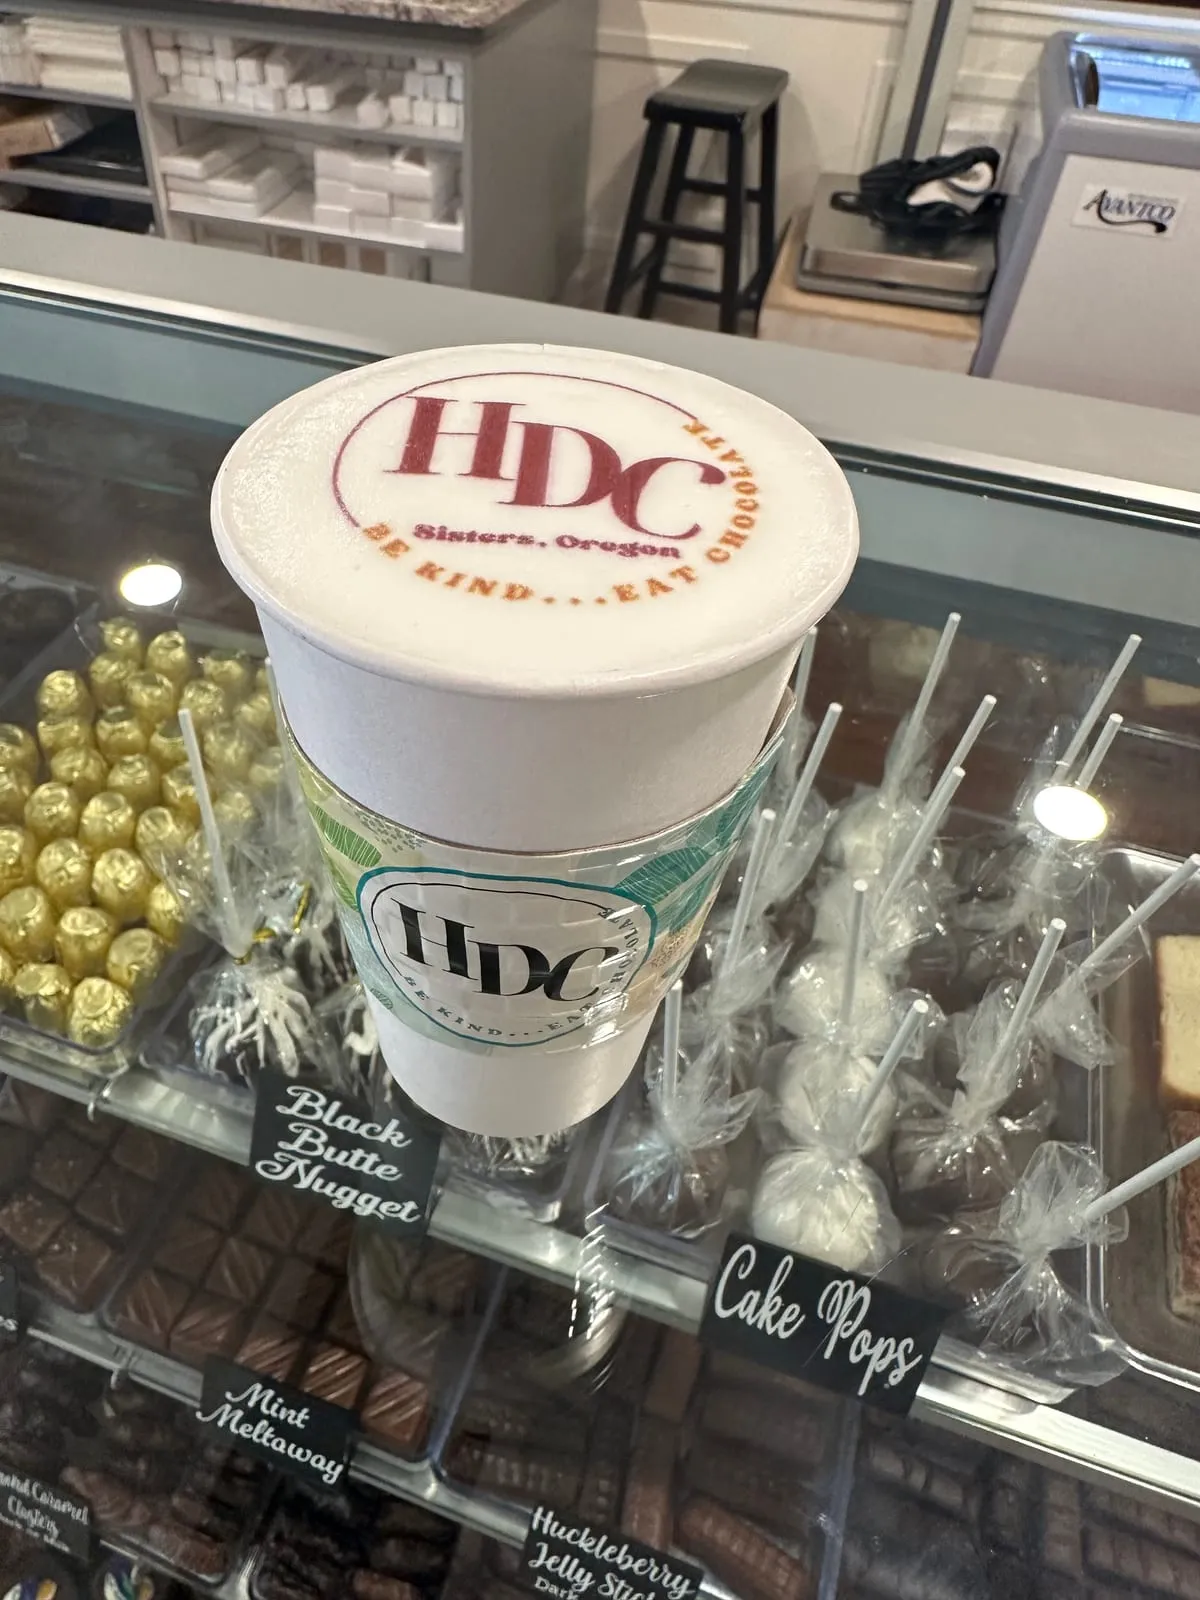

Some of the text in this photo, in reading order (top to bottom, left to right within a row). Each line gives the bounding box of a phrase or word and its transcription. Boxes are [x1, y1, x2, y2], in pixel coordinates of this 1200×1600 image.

[382, 395, 727, 541] HDC
[555, 533, 682, 559] Oregon
[612, 562, 699, 603] EAT
[681, 419, 761, 565] CHOCOLATE
[390, 896, 620, 1002] HDC
[598, 906, 641, 996] CHOOLATE
[274, 1085, 413, 1148] Black
[276, 1121, 403, 1182] Butte
[254, 1151, 422, 1223] Nugget
[714, 1243, 924, 1397] Cake Pops
[194, 1403, 345, 1486] Meltaway
[224, 1382, 311, 1429] Mint
[527, 1541, 597, 1592] Jelly
[532, 1506, 696, 1600] Huckleberry
